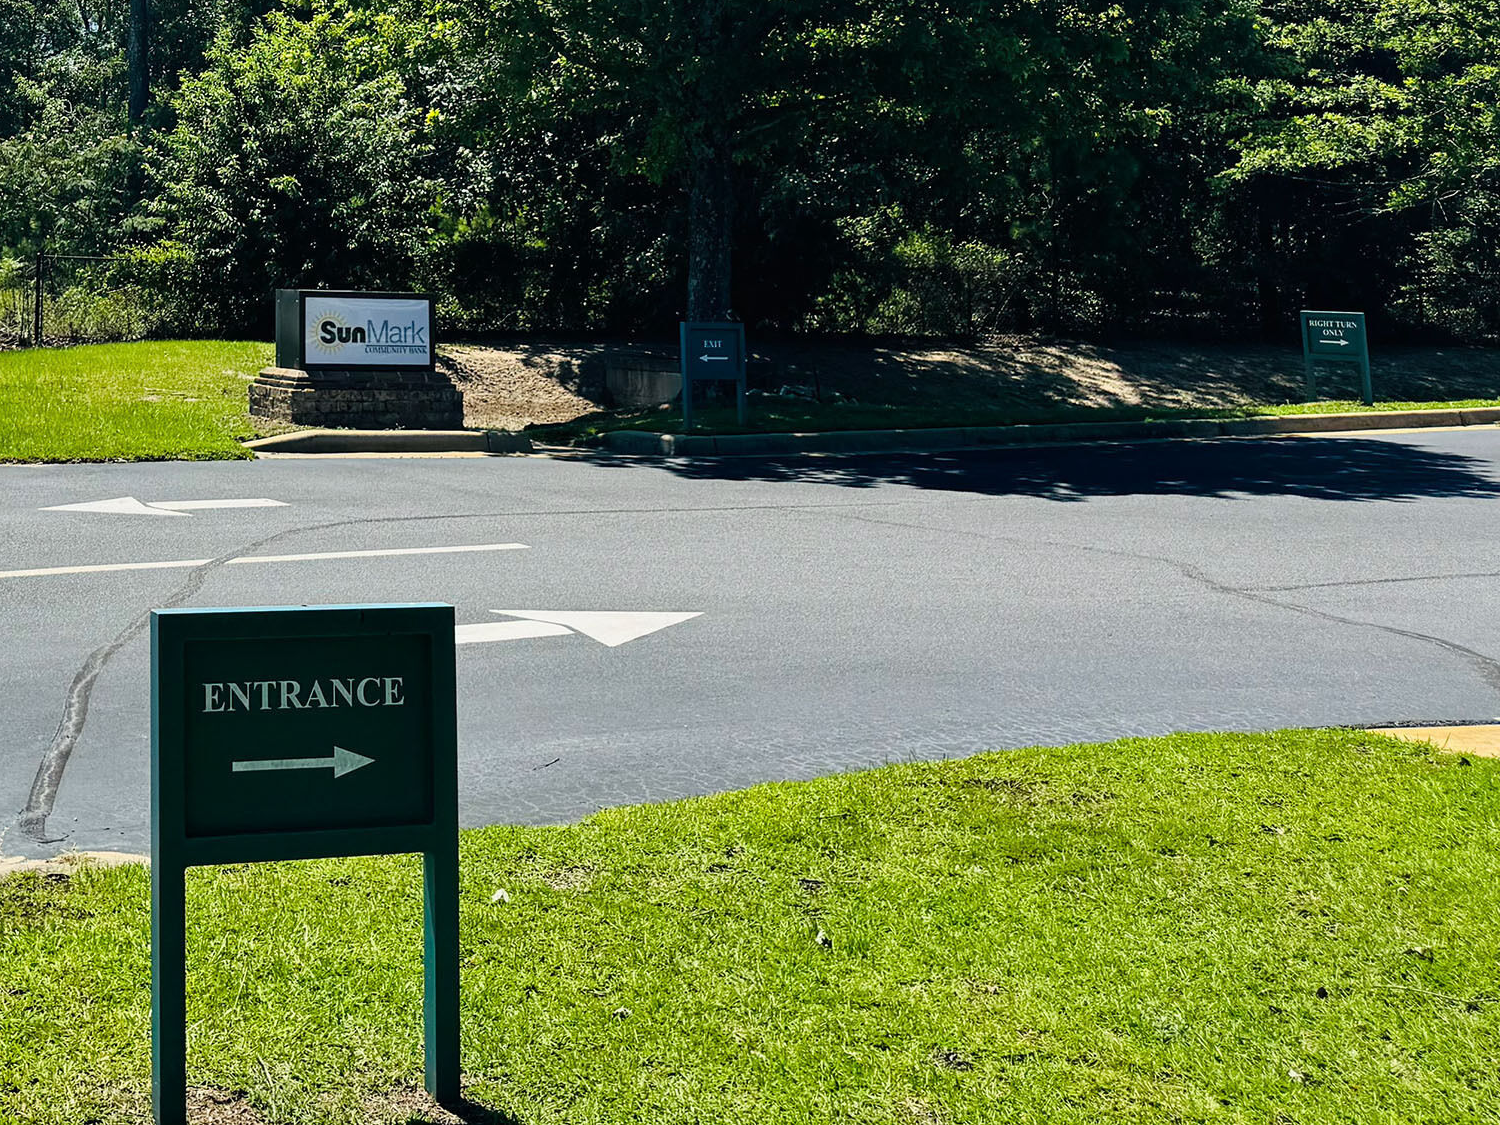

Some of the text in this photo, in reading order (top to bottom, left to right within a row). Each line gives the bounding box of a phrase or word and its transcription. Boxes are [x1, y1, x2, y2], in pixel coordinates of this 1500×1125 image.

[1309, 320, 1357, 329] RIGHT TURN
[320, 320, 425, 344] SunMark
[1322, 329, 1345, 337] ONLY
[703, 340, 723, 348] EXIT
[409, 347, 428, 355] BANK
[202, 677, 405, 713] ENTRANCE
